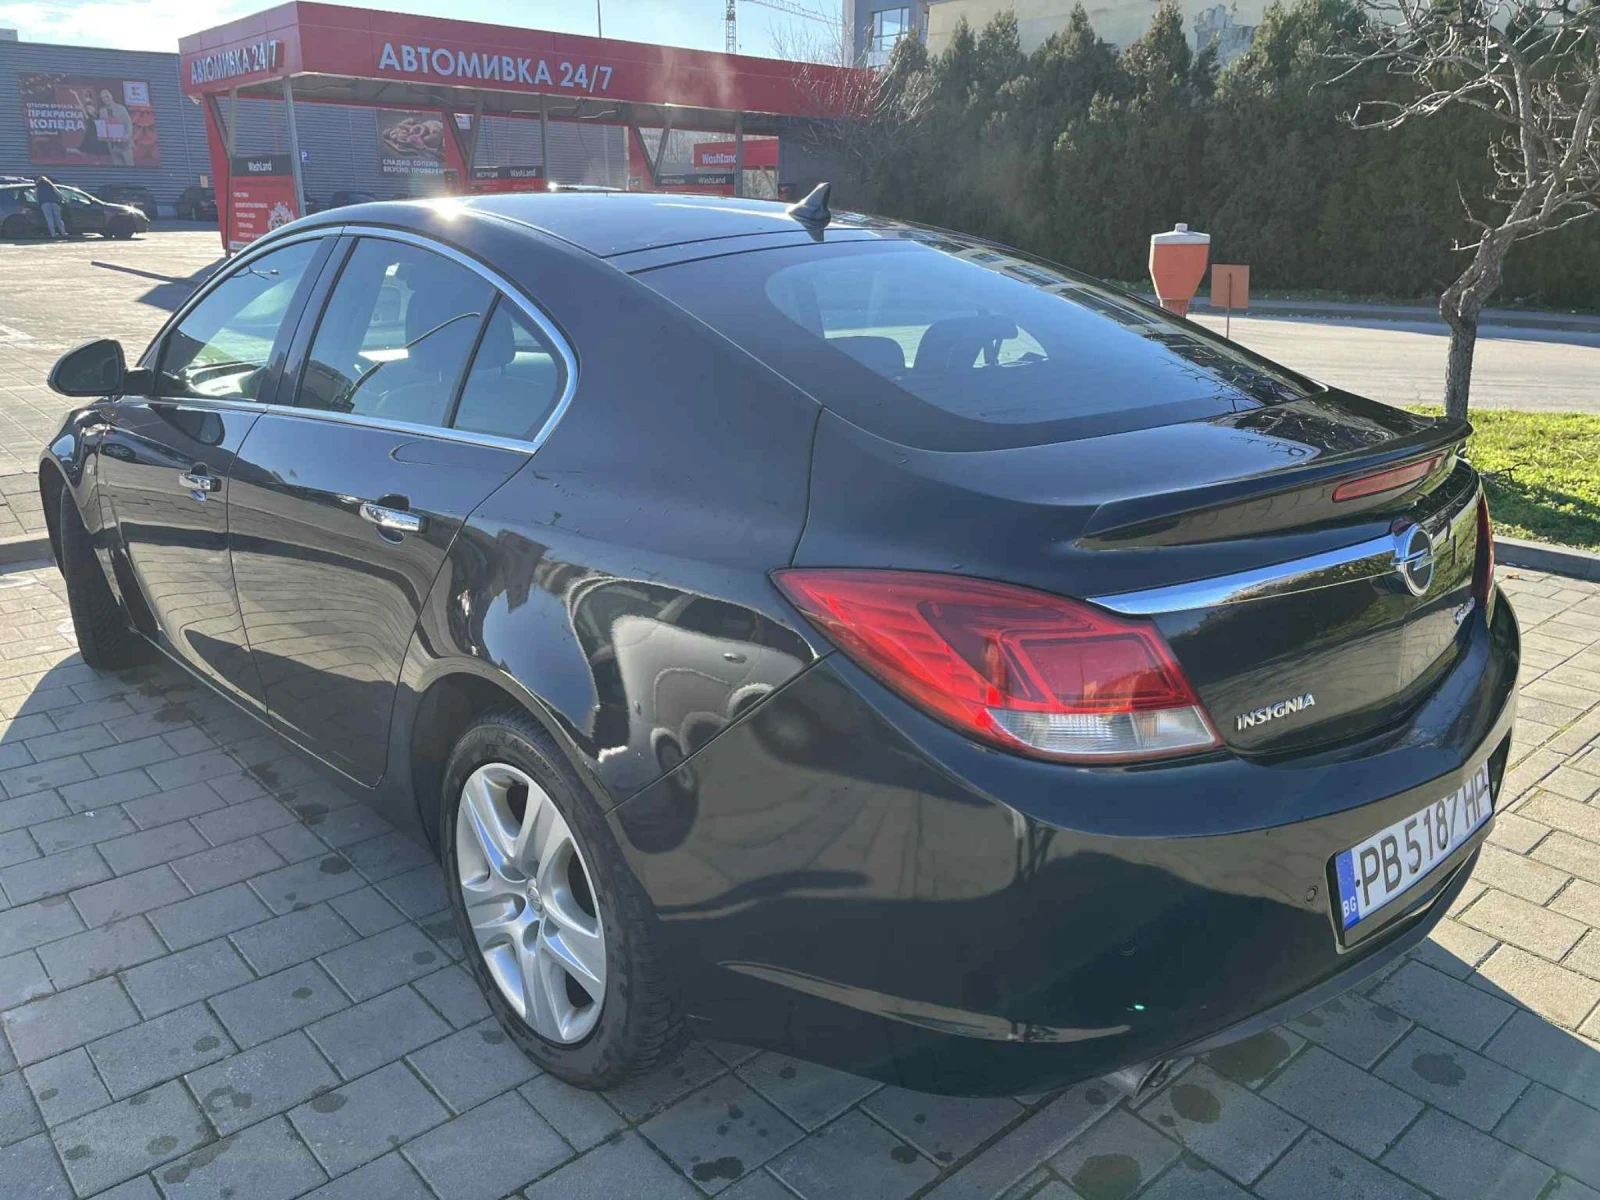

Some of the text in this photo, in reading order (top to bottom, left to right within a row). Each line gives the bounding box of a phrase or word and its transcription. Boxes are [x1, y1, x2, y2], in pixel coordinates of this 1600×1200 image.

[191, 40, 277, 85] АВТОМИВКА 24/7
[379, 43, 613, 93] АВТОМИВКА 24/7
[28, 109, 84, 119] ПРЕКРАСНА
[30, 118, 86, 131] КОЛЕДА
[1235, 692, 1316, 731] INSIGNIA
[1342, 896, 1357, 917] BG
